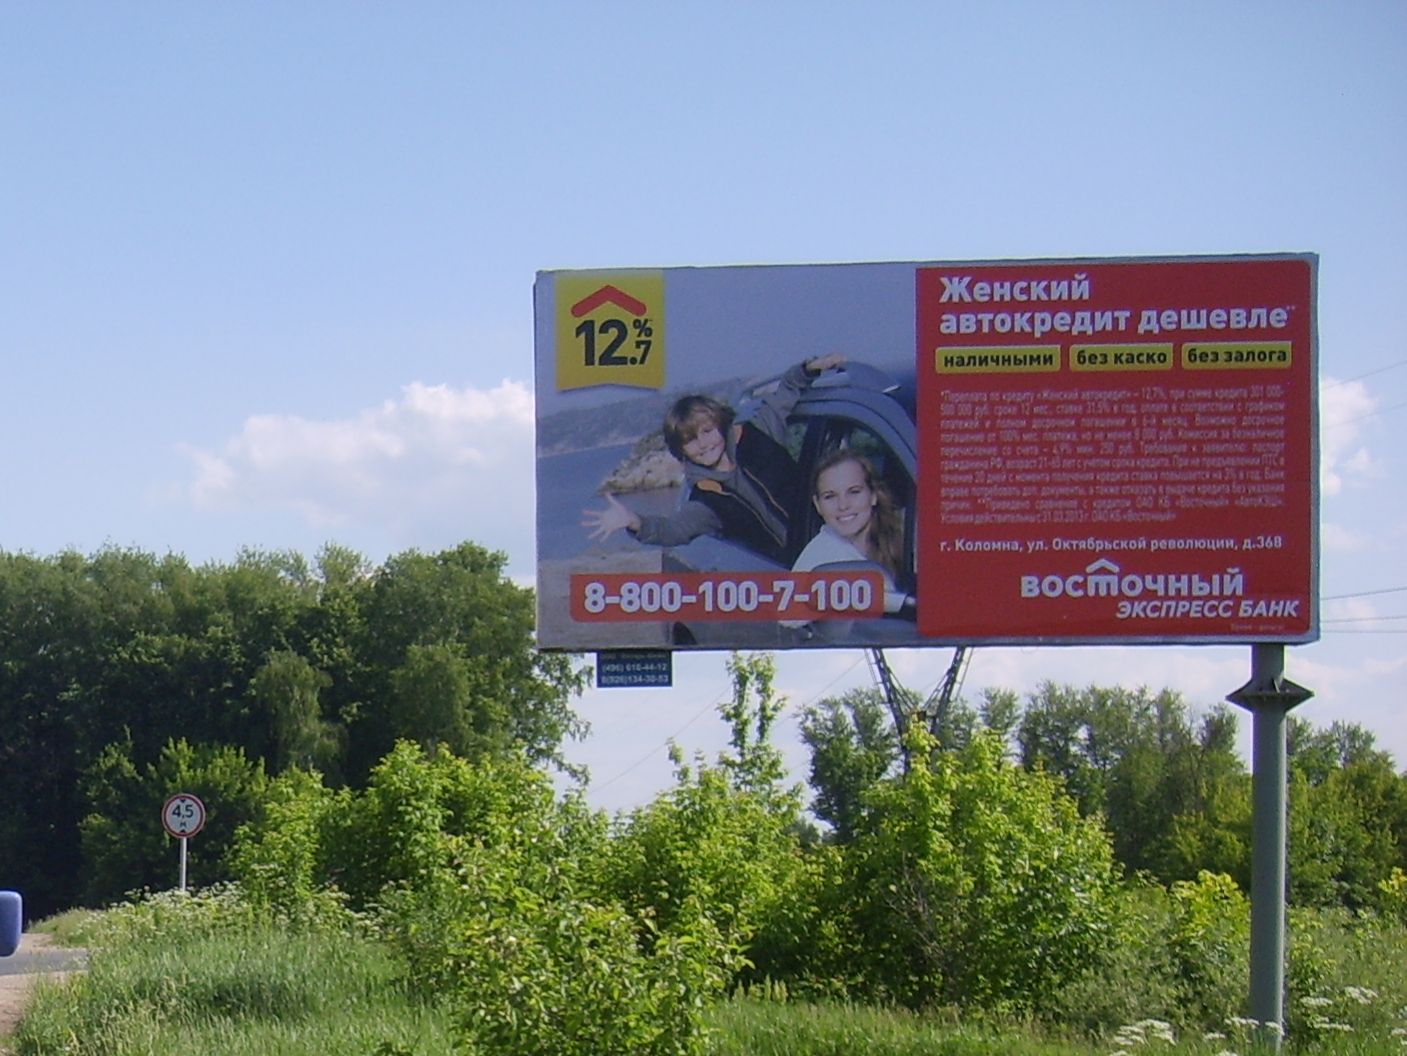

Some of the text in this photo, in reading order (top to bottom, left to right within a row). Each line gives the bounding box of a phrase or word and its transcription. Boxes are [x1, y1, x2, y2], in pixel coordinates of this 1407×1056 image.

[939, 273, 1090, 303] Женский
[939, 309, 1131, 338] автокредит
[943, 352, 1054, 368] наличными
[1076, 350, 1168, 366] без каско
[1188, 348, 1288, 364] без залога
[940, 536, 1283, 555] г. Коломна, ул. Октябрьской революции, д.368
[583, 578, 872, 614] 8-800-100-7-100
[1116, 599, 1300, 619] ЭКСПРЕСС БАНК
